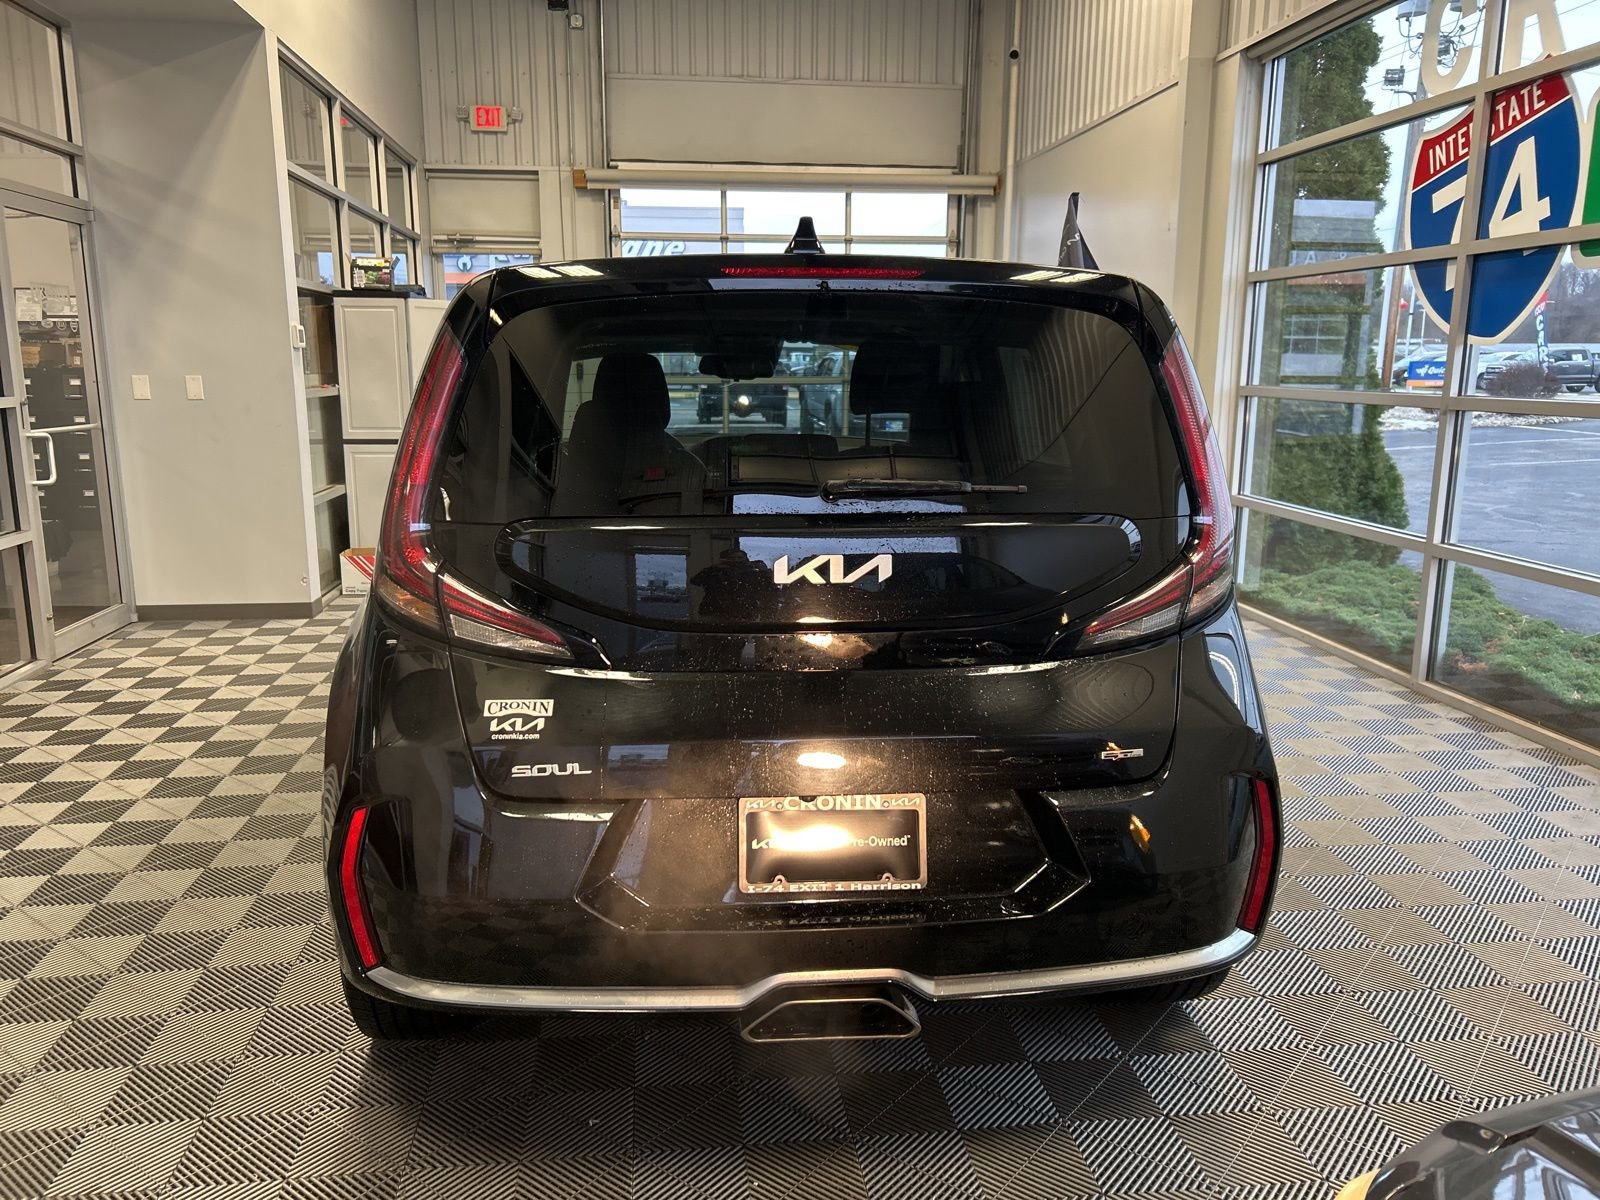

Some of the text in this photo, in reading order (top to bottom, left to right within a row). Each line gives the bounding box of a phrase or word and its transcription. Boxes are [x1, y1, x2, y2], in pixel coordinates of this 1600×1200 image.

[475, 106, 501, 129] EXIT
[1428, 78, 1546, 176] INTETATE
[1432, 136, 1551, 293] 74
[774, 555, 893, 584] KIA
[488, 701, 550, 715] CRONIN
[490, 718, 545, 731] KIA
[511, 763, 592, 777] SOUL
[746, 795, 920, 811] KIA CRONIN KIA
[747, 881, 921, 894] I-74 EXIT 1 Harrison
